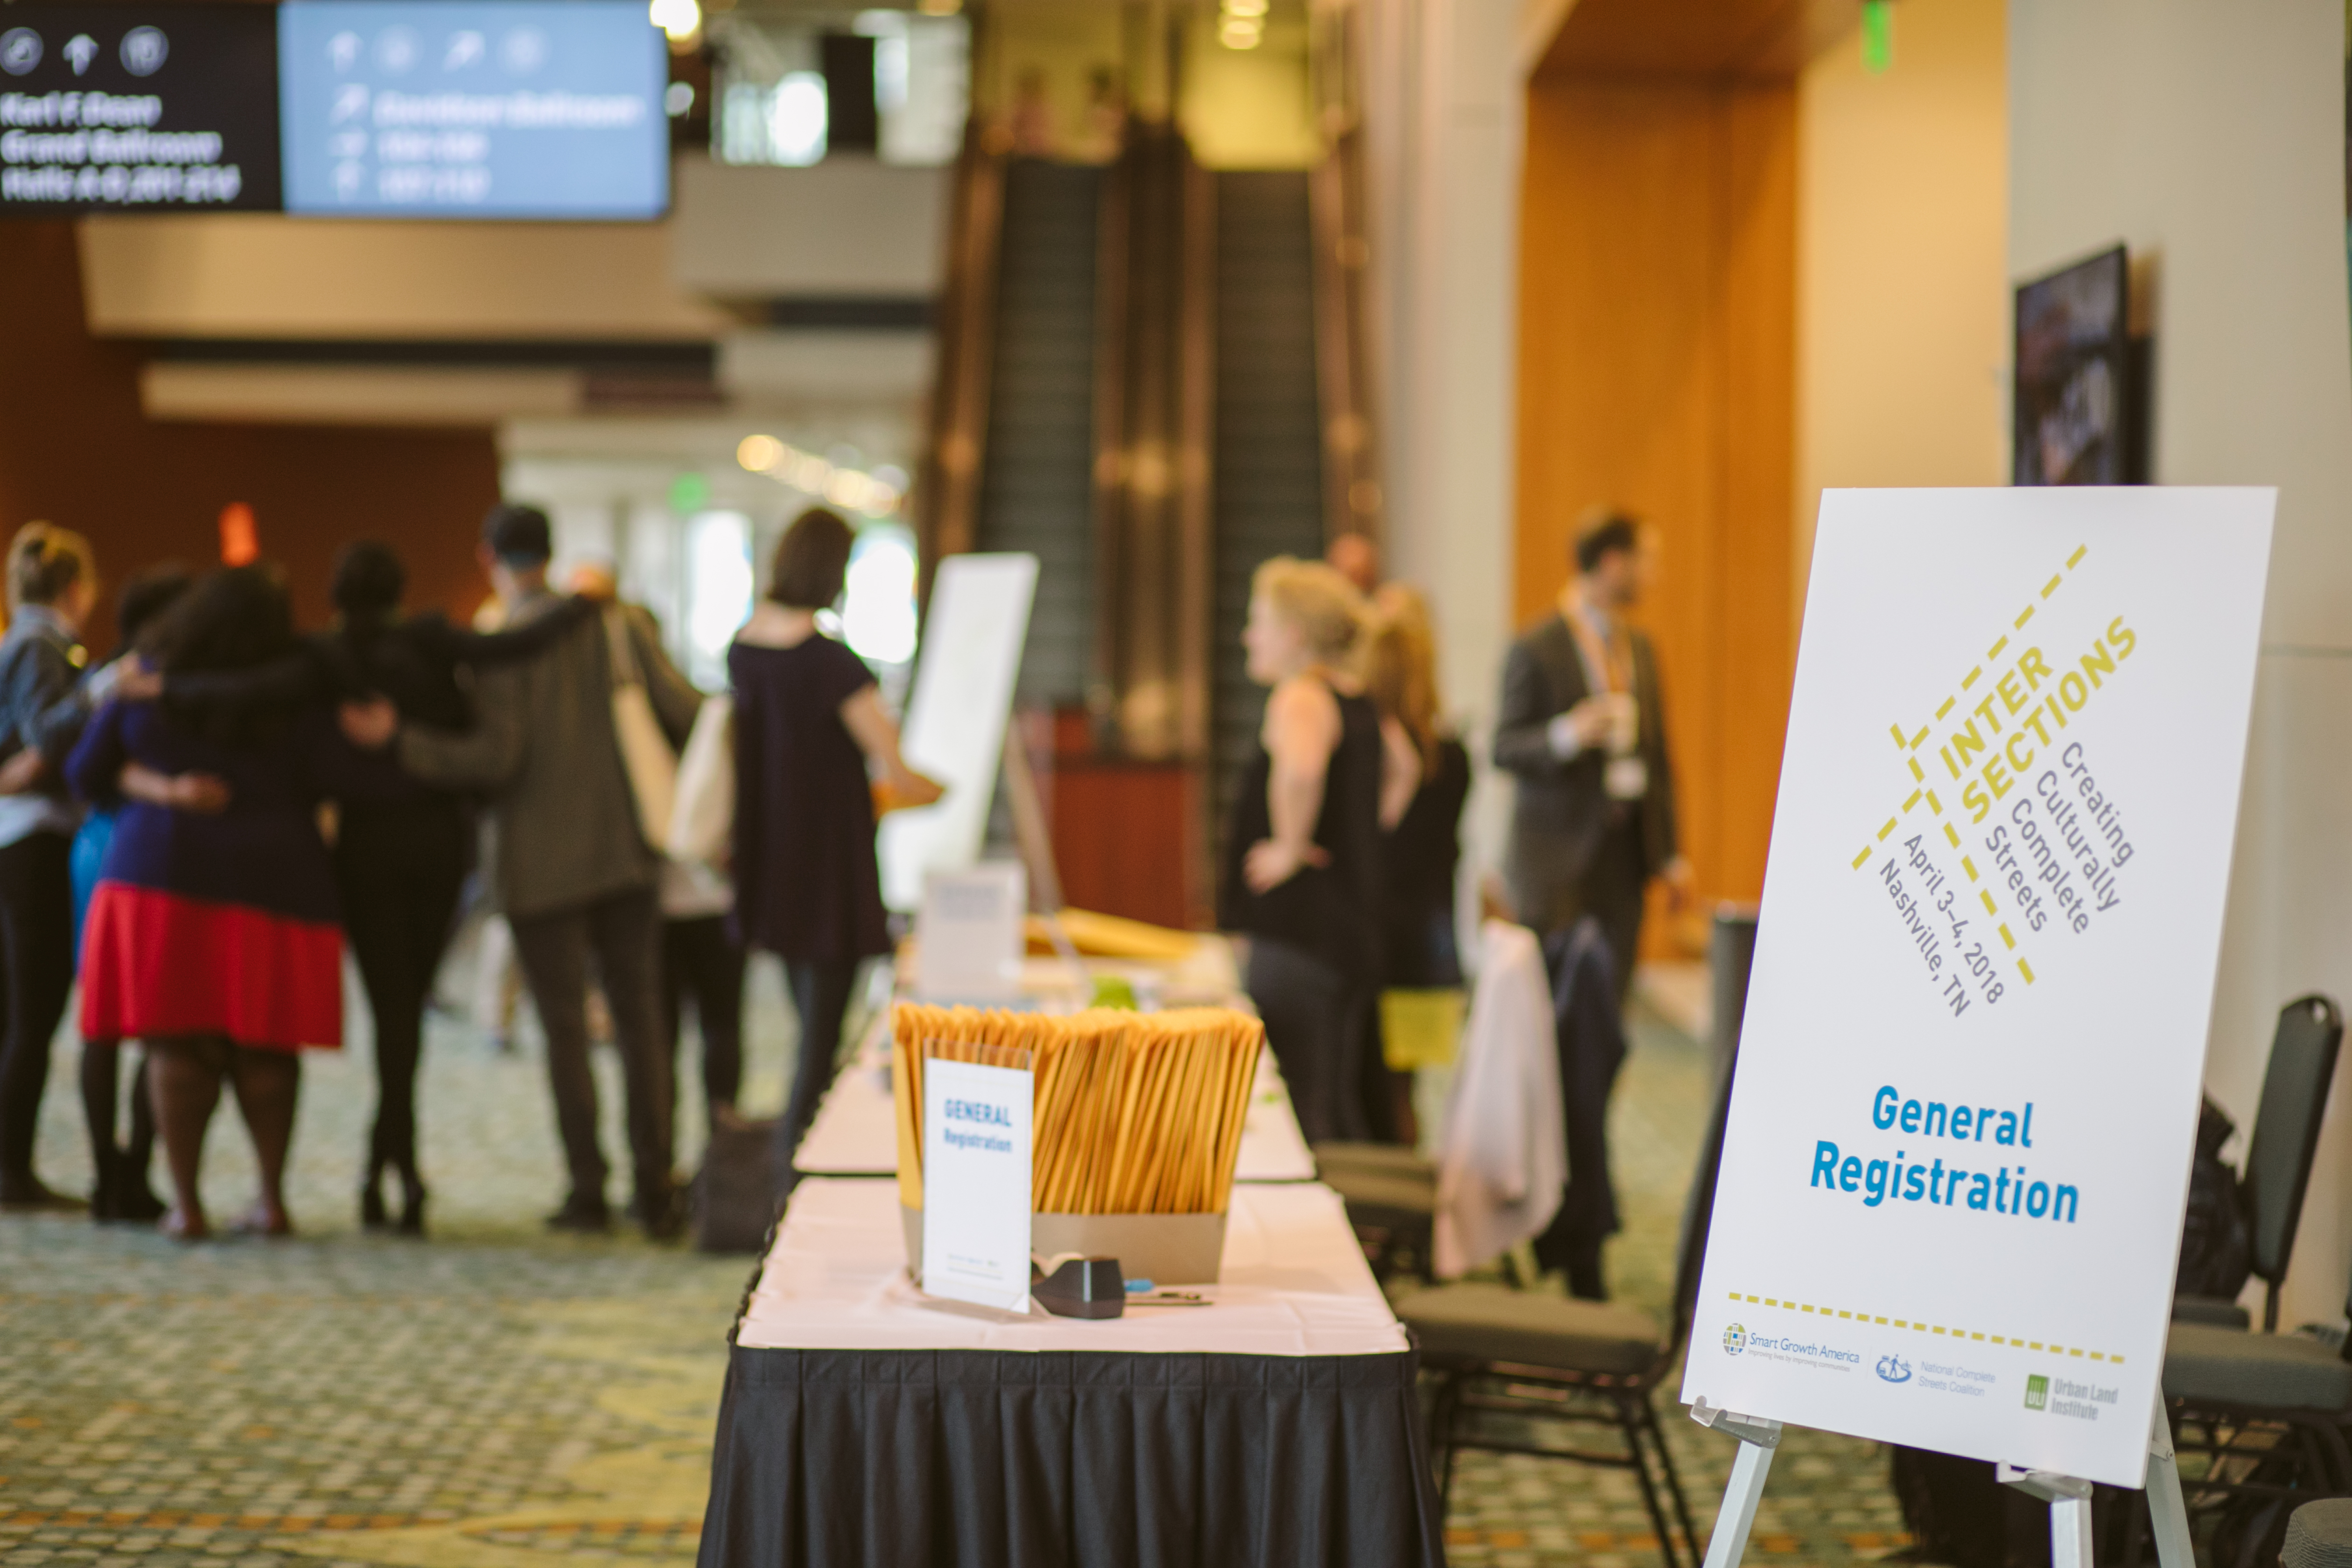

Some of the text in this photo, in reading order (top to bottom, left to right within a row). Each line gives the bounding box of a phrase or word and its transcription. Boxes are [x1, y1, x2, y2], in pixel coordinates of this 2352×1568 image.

[1939, 646, 2054, 781] INTER
[1961, 615, 2137, 825] SECTIONS
[2036, 770, 2121, 912] Culturally
[2061, 741, 2135, 869] Creating
[1985, 825, 2048, 932] Streets
[2011, 798, 2090, 935] Complete
[1879, 858, 1971, 1018] Nashville, TN
[1903, 833, 1946, 896] April
[1963, 942, 2005, 1005] 2018
[943, 1127, 1012, 1153] Registration
[944, 1099, 1012, 1127] GENERAL
[1872, 1085, 2034, 1148] General
[1810, 1140, 2080, 1224] Registration
[1748, 1348, 1851, 1372] Improving lives by improving communities
[1750, 1332, 1860, 1364] Smart Growth America
[1920, 1360, 1996, 1384] National Complete
[1918, 1376, 1985, 1397] Streets Coalition
[2051, 1397, 2100, 1421] Institute
[2054, 1377, 2119, 1404] Urban Land
